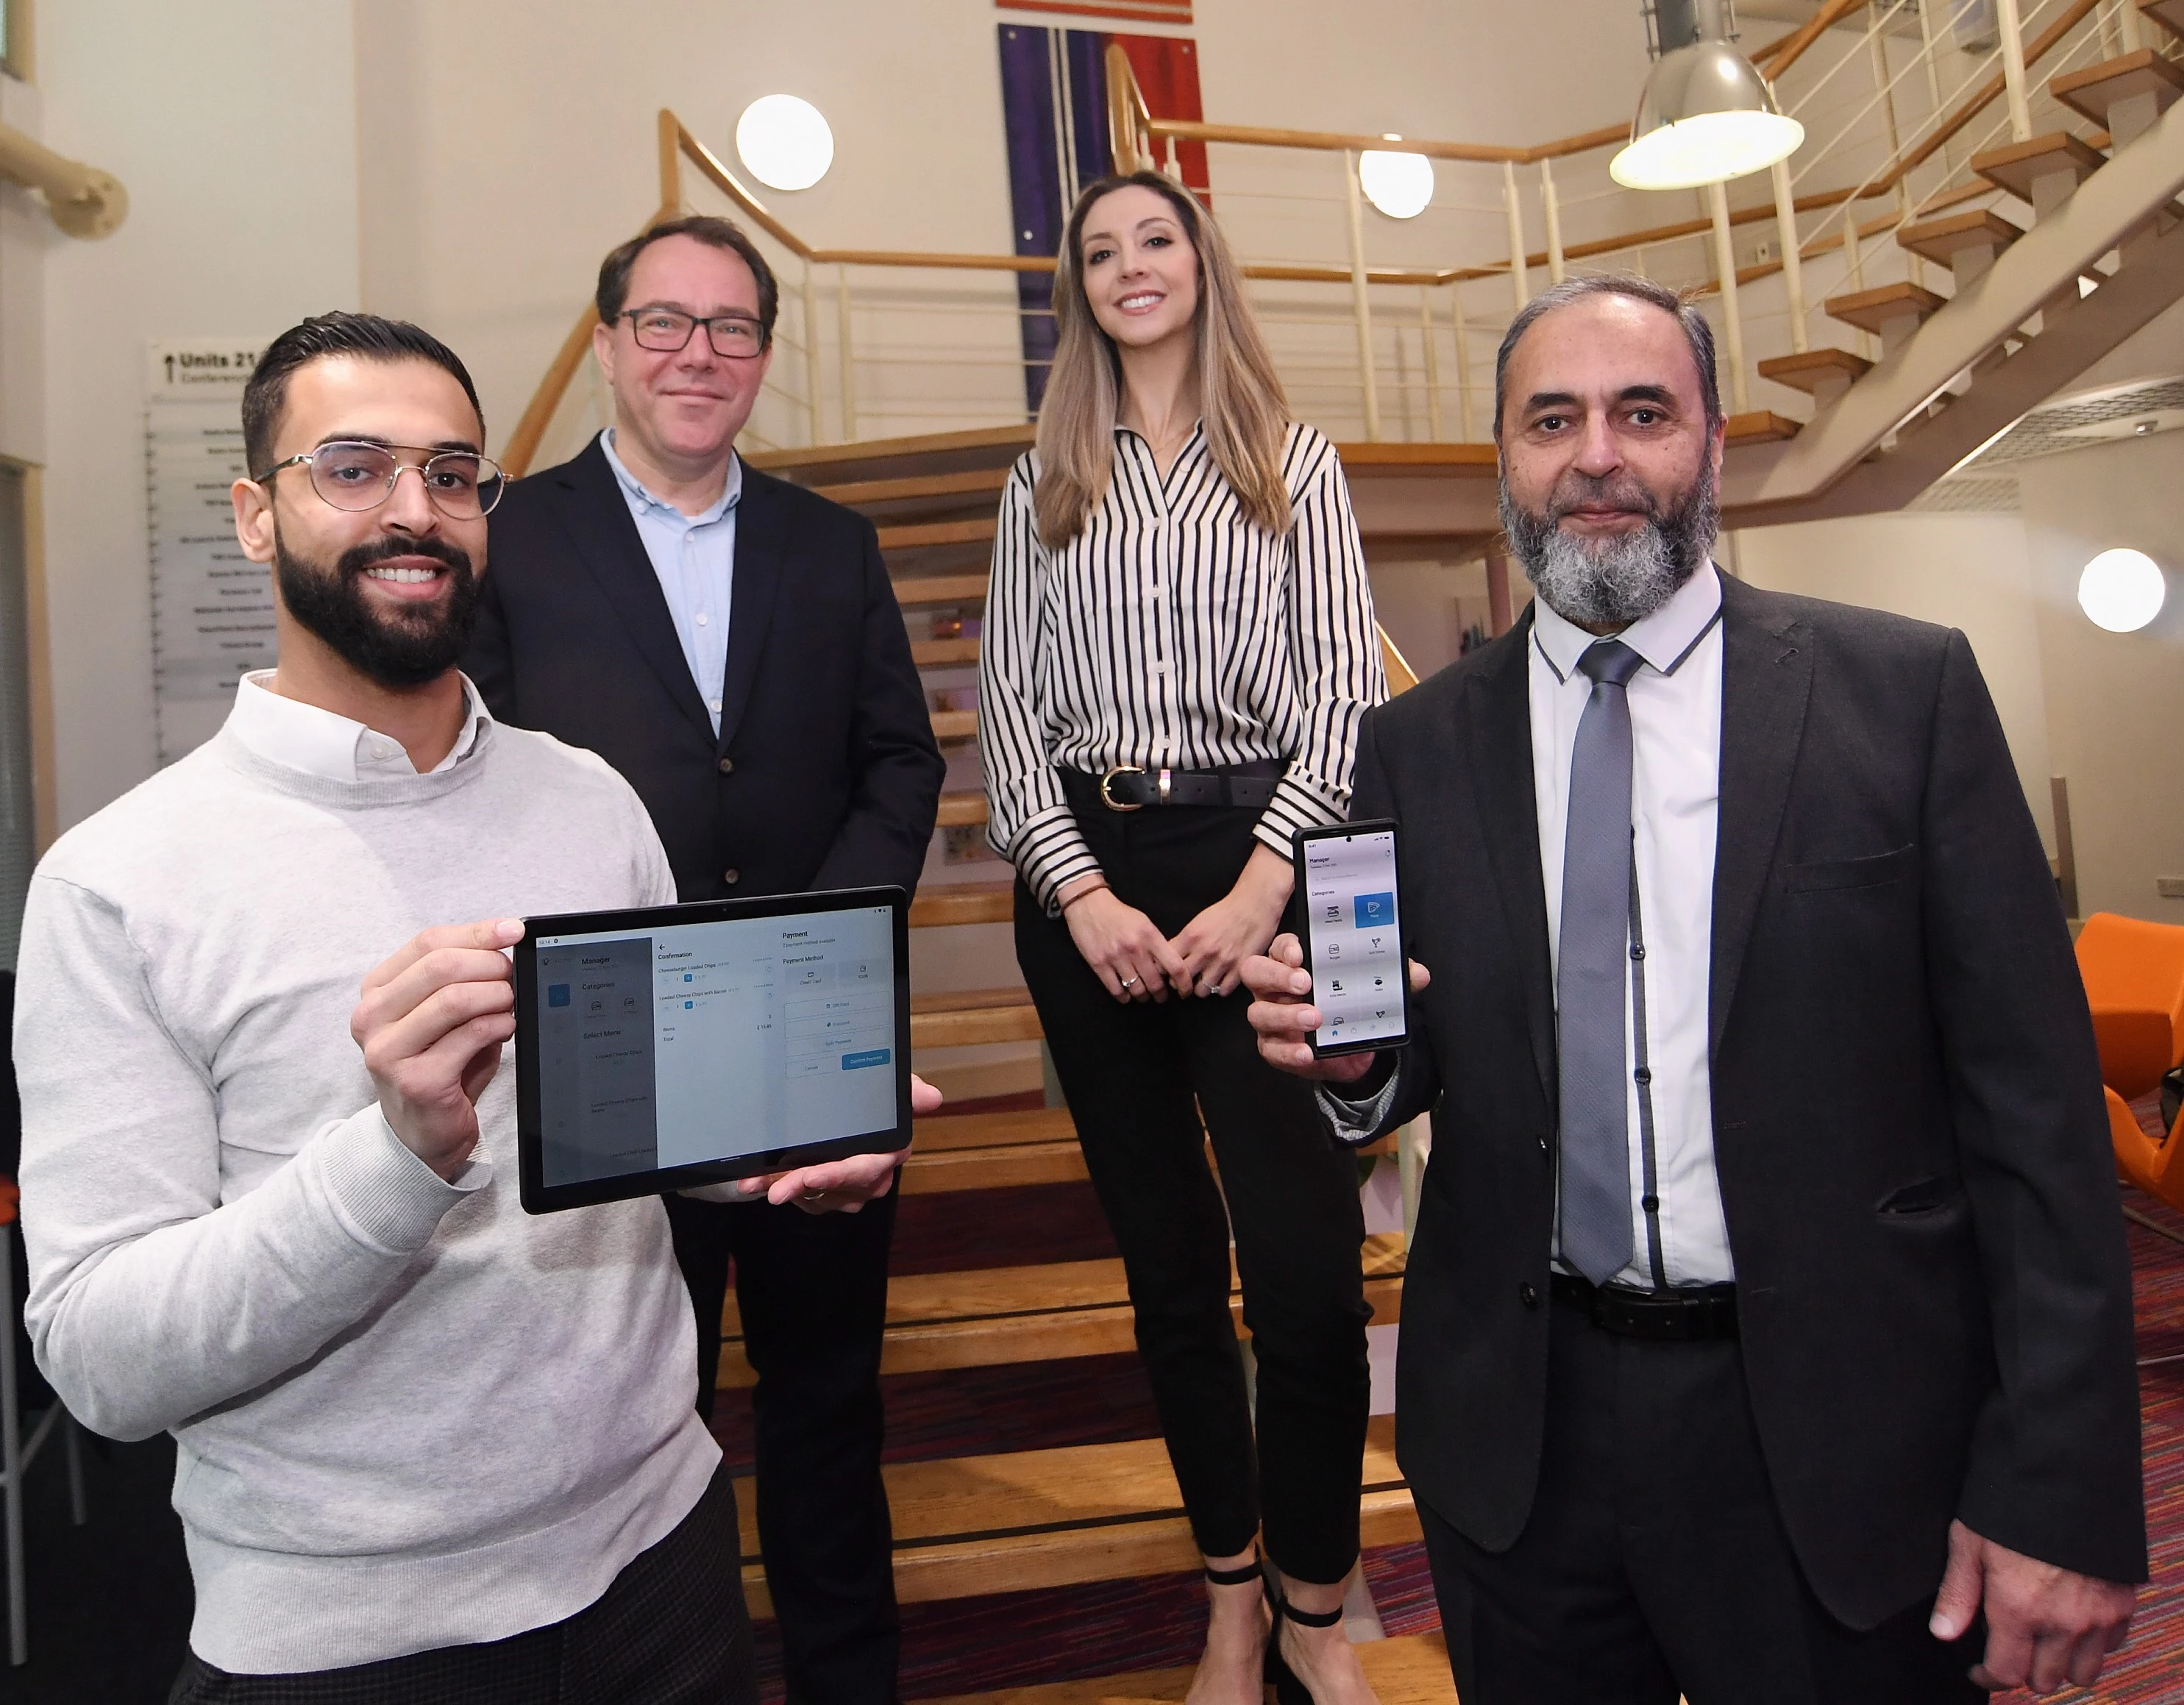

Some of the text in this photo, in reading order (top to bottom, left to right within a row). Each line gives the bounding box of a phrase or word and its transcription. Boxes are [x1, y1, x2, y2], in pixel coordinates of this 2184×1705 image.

[180, 353, 229, 367] Units
[782, 930, 808, 939] Payment
[658, 952, 692, 960] Confirmation
[582, 957, 611, 965] Manager
[582, 982, 615, 990] Categories
[583, 1031, 602, 1039] Select
